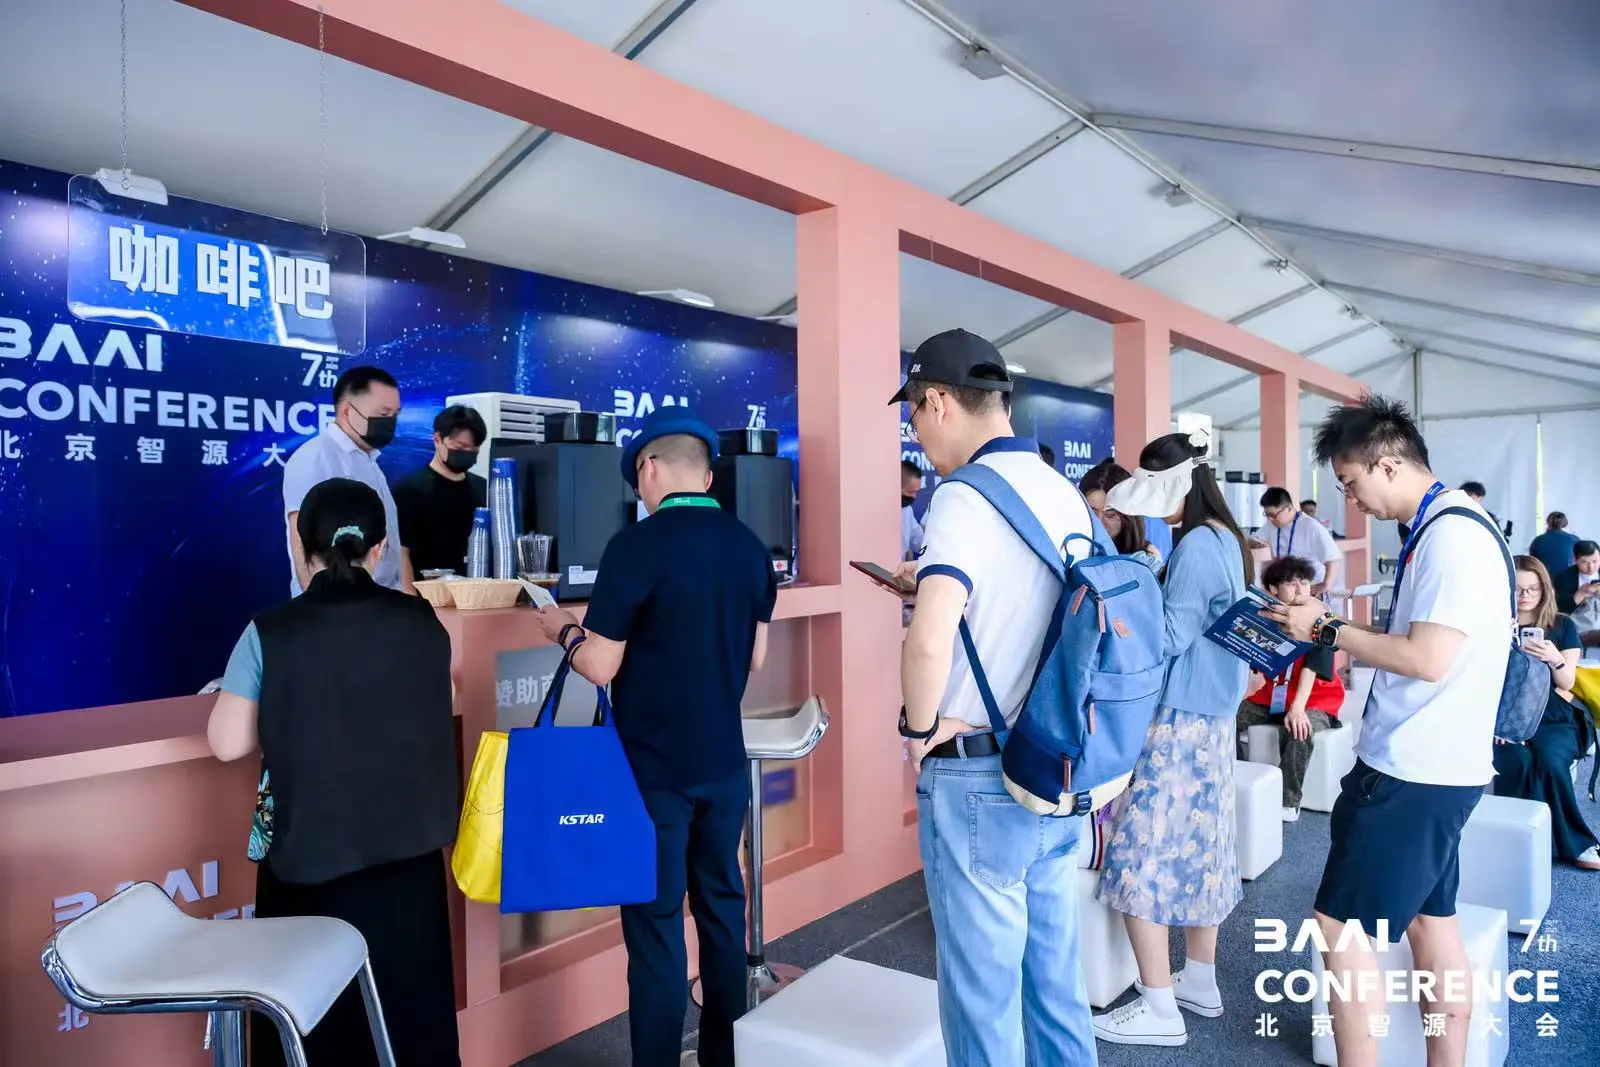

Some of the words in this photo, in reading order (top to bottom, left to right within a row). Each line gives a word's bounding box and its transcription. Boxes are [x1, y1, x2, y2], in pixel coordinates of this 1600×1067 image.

[109, 224, 333, 320] 咖啡吧
[0, 316, 163, 372] BAAI
[301, 352, 338, 388] 7th
[559, 813, 605, 825] KSTAR
